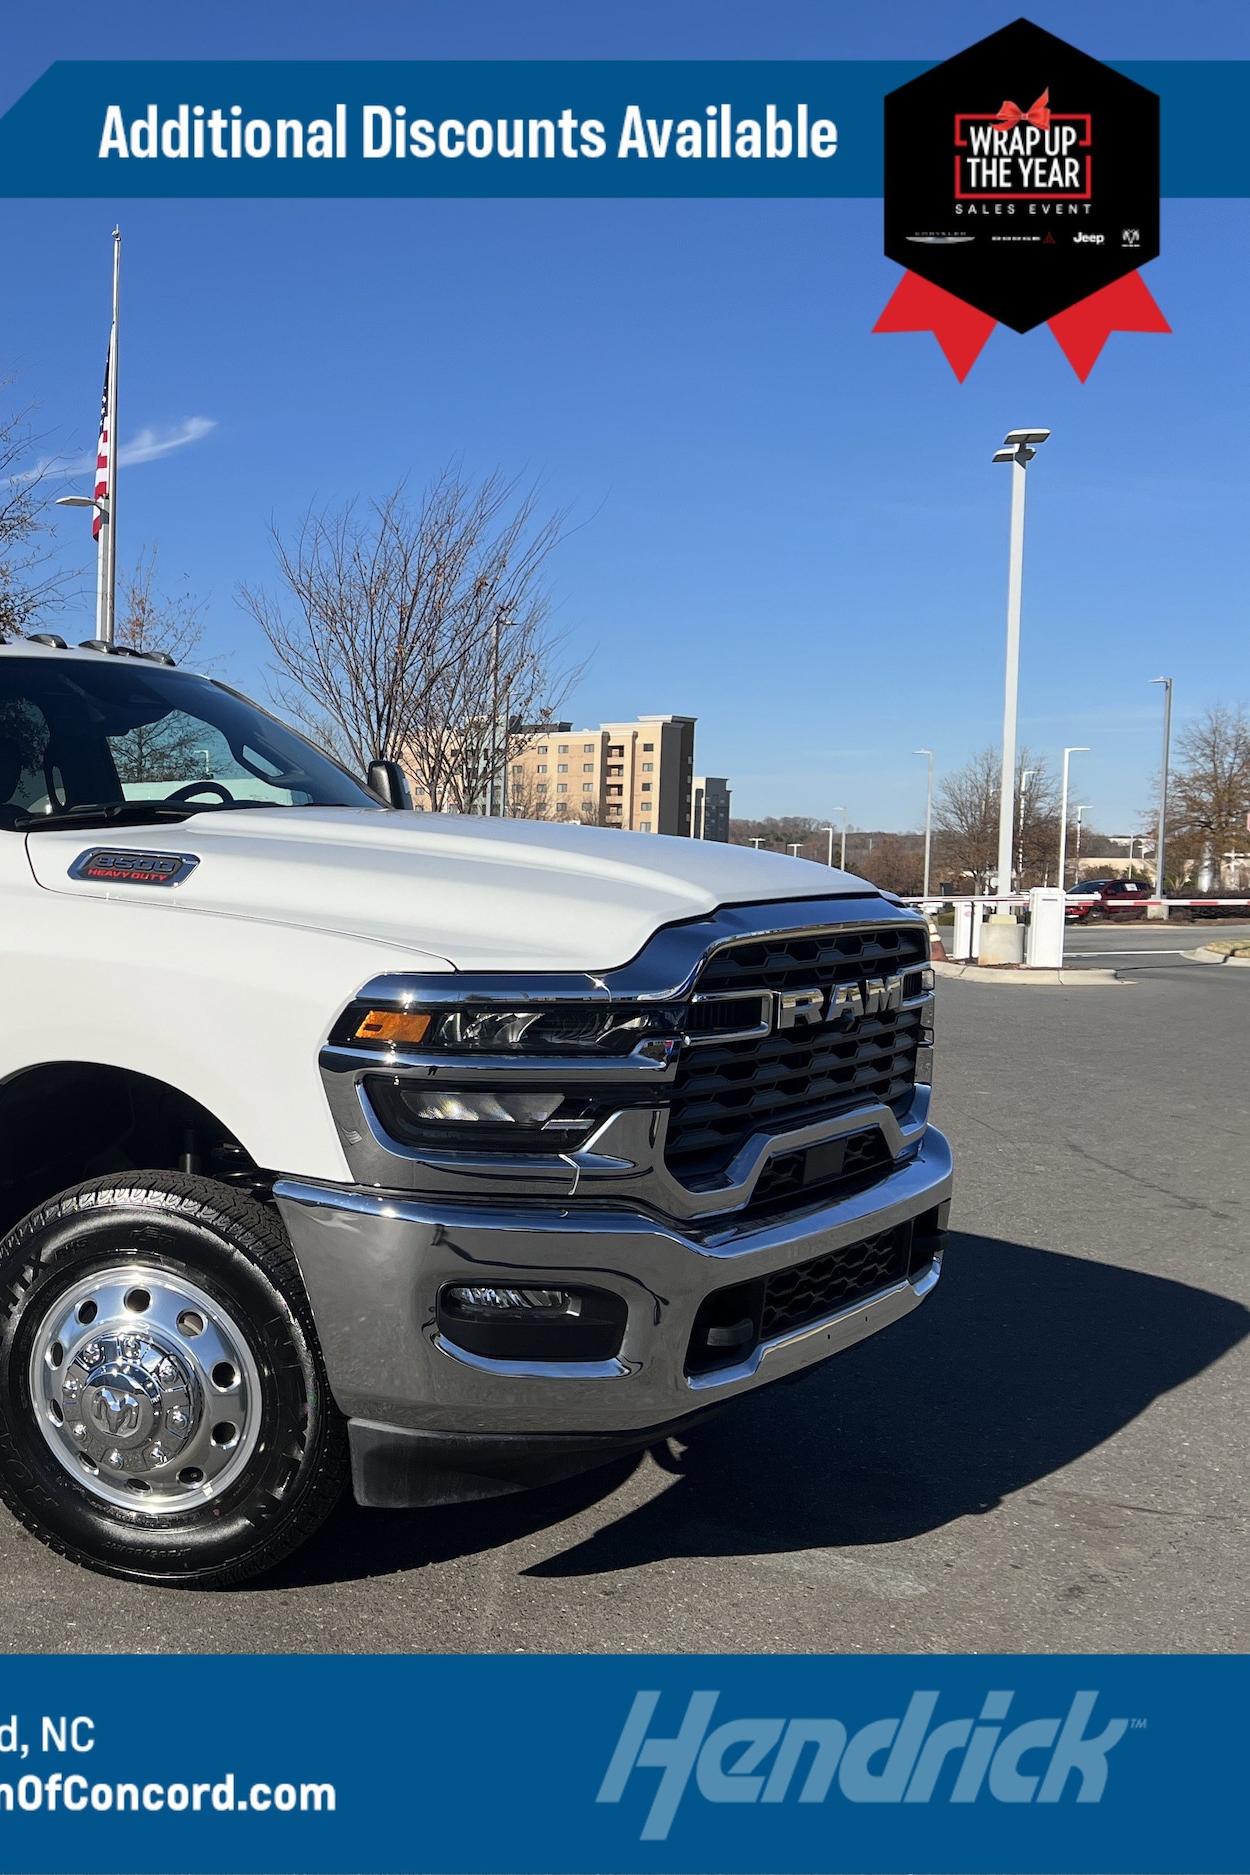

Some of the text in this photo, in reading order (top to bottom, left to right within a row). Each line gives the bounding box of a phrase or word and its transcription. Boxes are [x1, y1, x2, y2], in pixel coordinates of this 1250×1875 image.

[94, 856, 176, 873] 3500
[87, 868, 169, 881] HEAVY DUTY
[779, 974, 902, 1030] RAM
